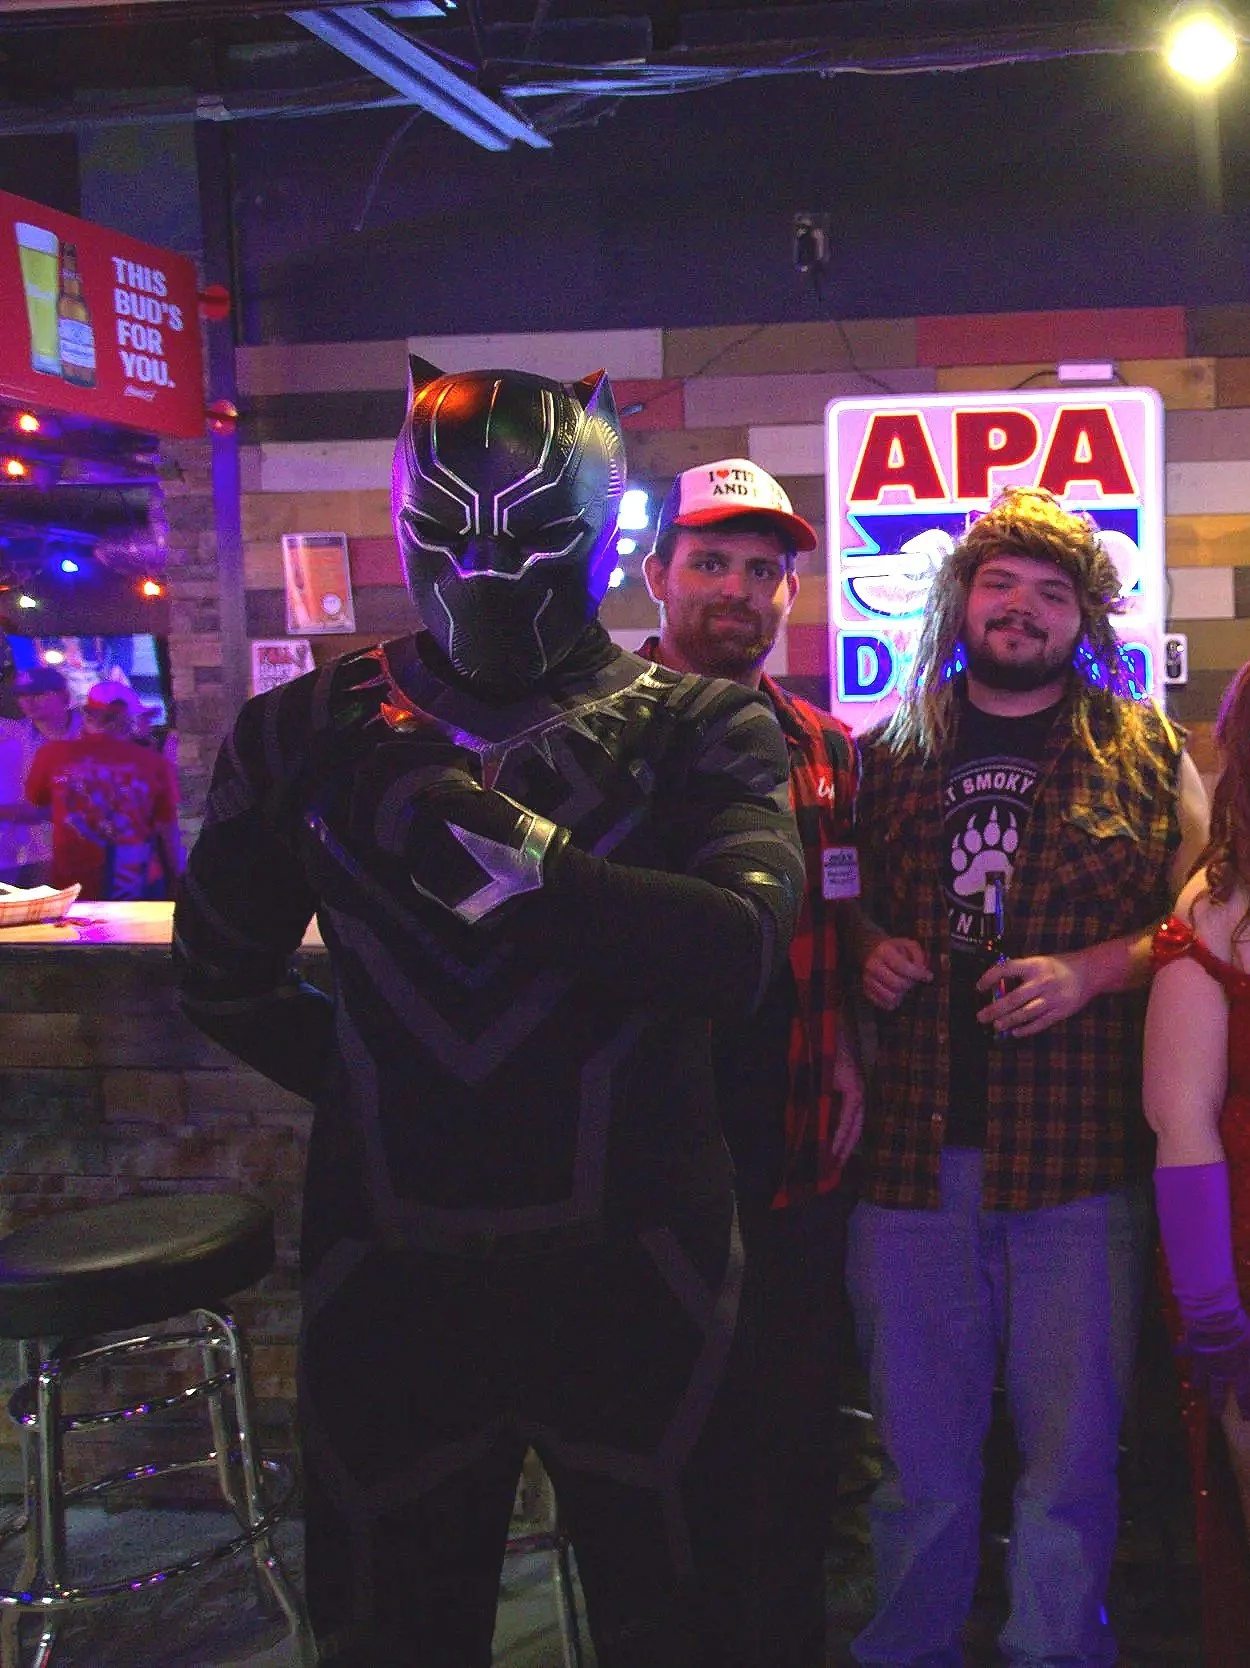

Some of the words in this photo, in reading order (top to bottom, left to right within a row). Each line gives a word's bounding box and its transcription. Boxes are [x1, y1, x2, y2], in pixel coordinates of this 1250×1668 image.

[112, 256, 167, 296] THIS
[114, 288, 183, 331] BUD'S
[117, 319, 163, 356] FOR
[118, 349, 176, 388] YOU.
[846, 403, 1140, 505] APA
[713, 484, 748, 496] AND
[962, 771, 1035, 795] SMOKY
